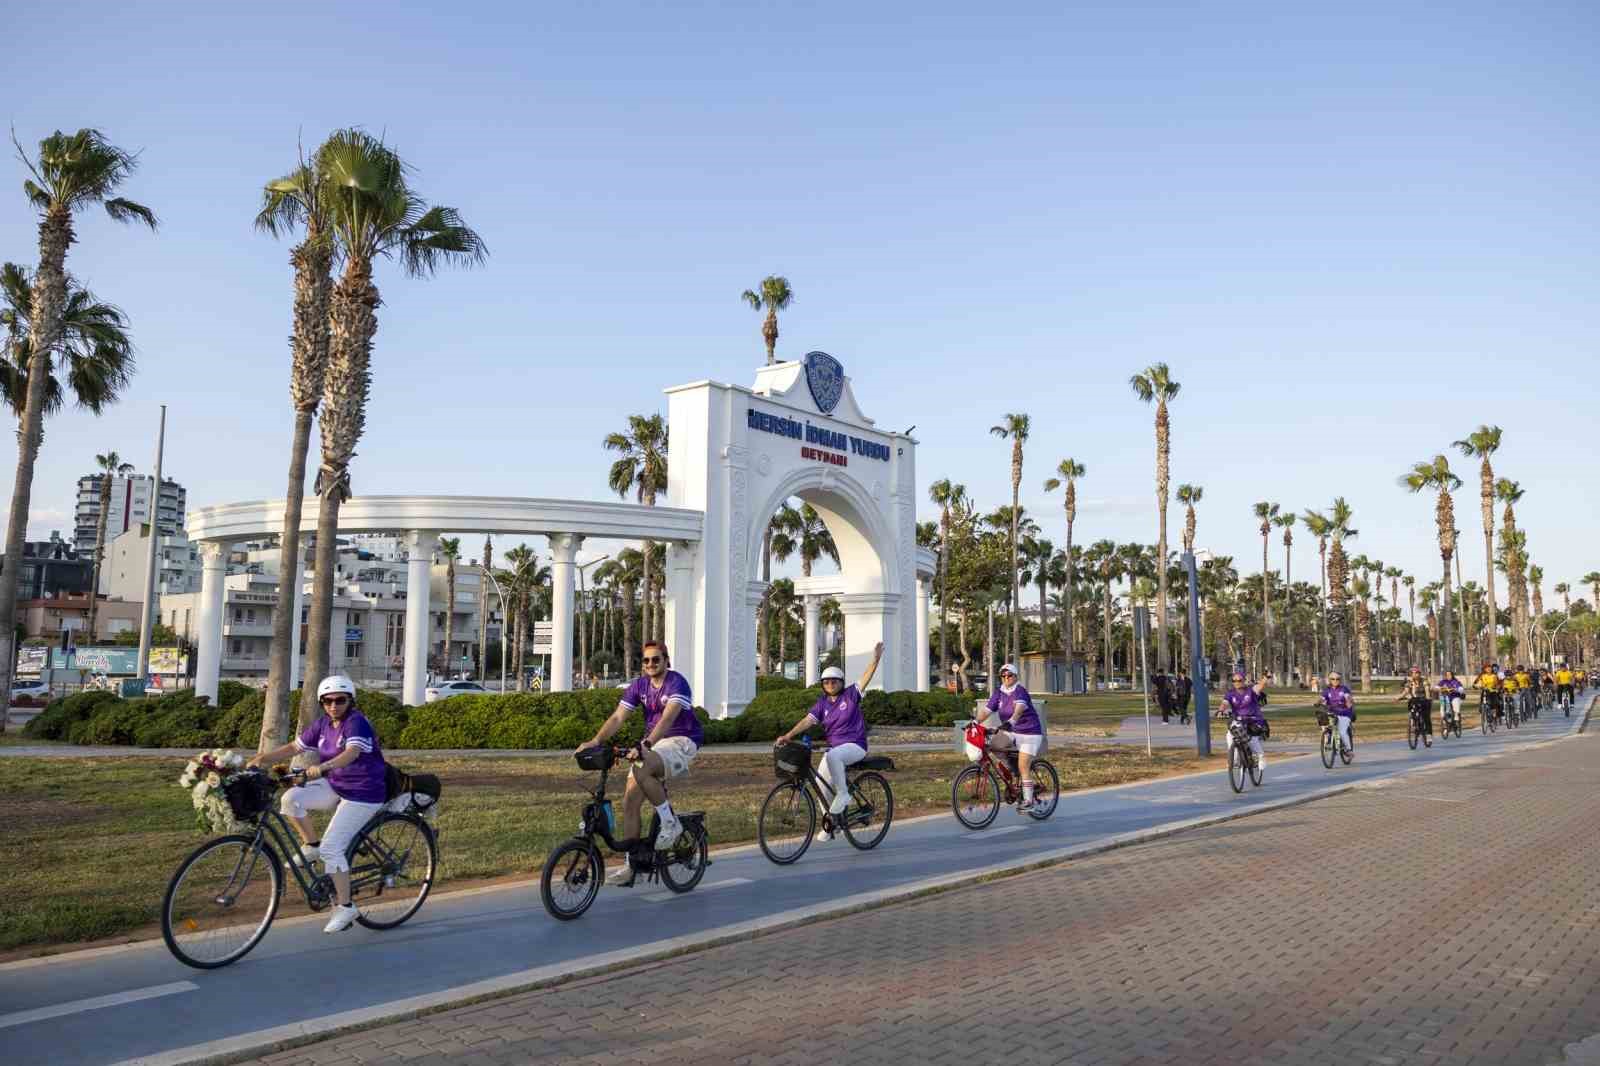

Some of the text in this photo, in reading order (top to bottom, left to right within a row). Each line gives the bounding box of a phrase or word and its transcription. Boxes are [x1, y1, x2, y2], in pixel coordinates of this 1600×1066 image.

[747, 408, 890, 462] MERSİN İDMAN YURDU
